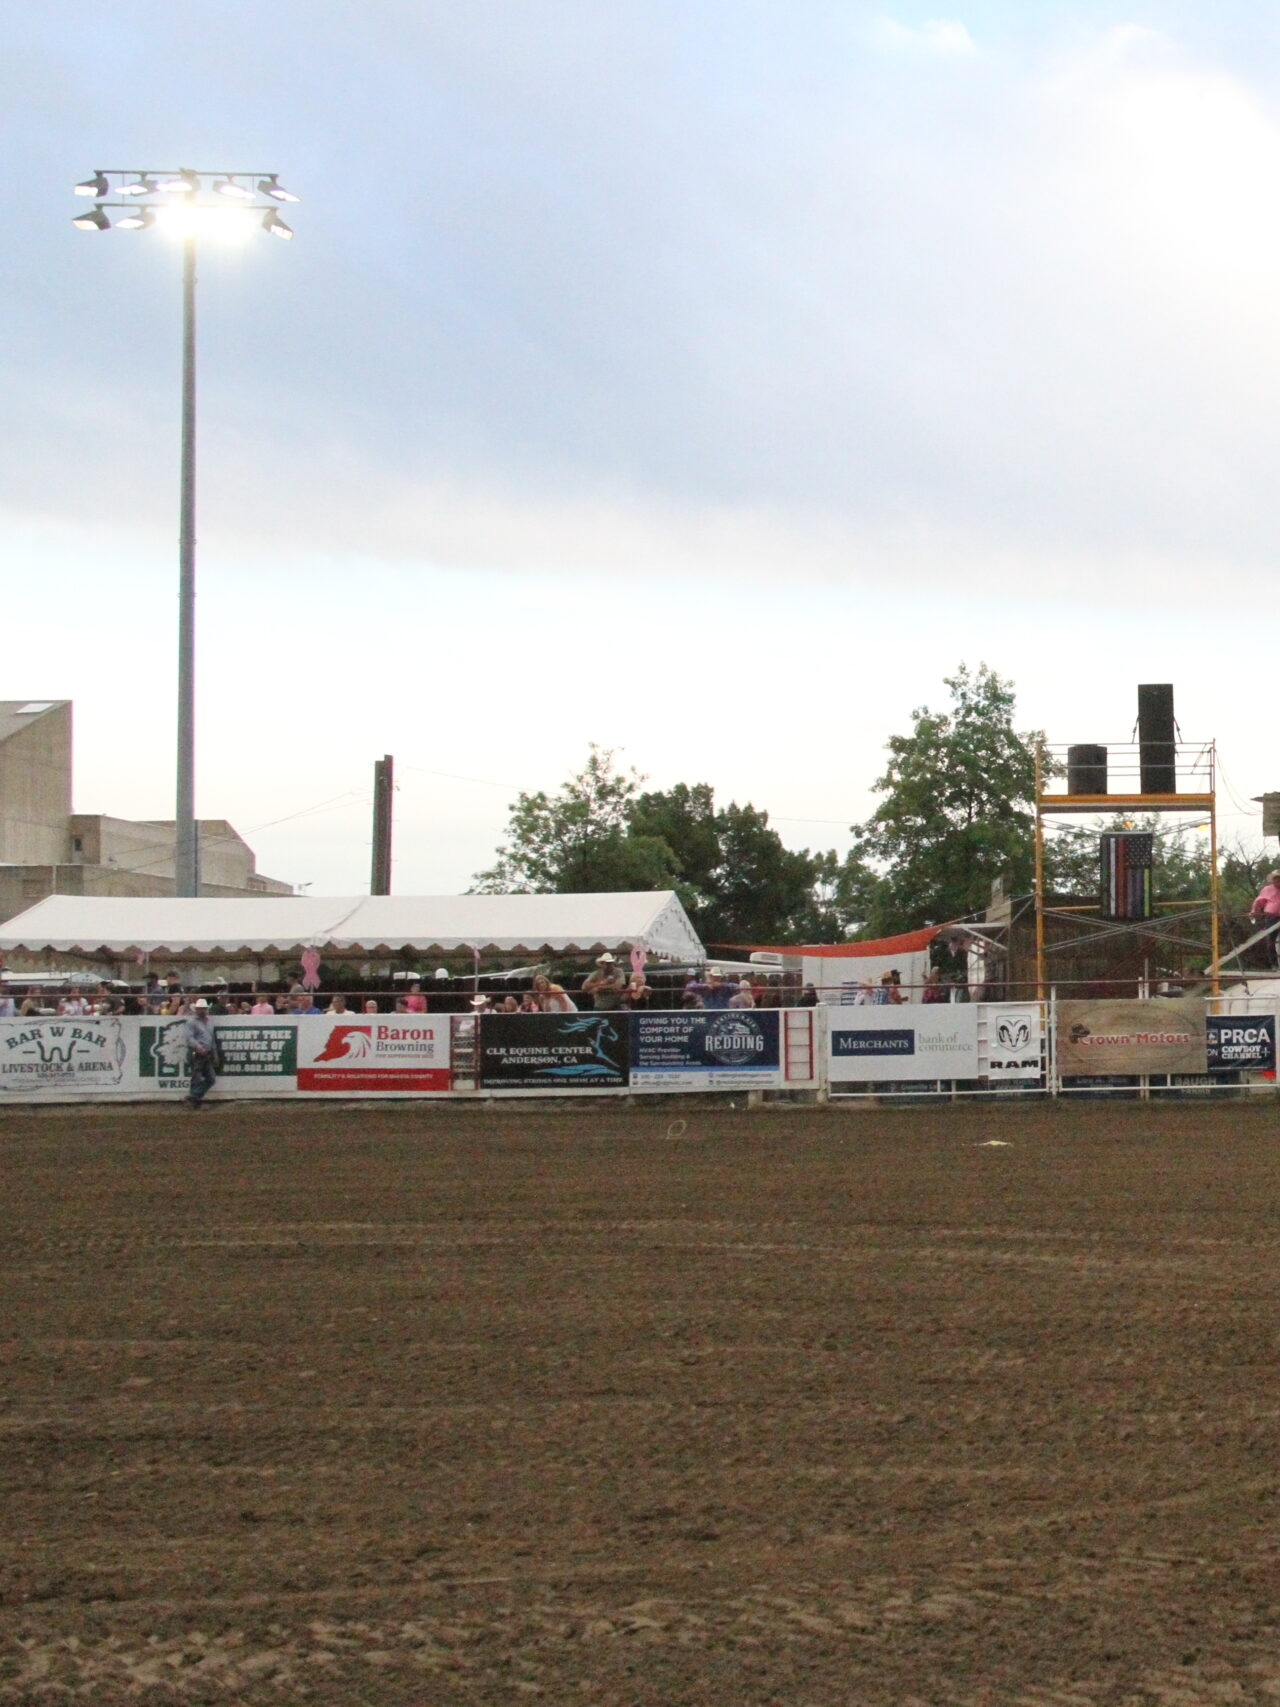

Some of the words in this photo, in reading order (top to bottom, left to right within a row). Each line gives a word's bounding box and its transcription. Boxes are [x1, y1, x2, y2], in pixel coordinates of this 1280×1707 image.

[639, 1017, 669, 1025] GIVING
[5, 1028, 43, 1049] BAR
[49, 1026, 65, 1037] W
[70, 1028, 107, 1048] BAR
[215, 1030, 259, 1040] WRIGHT
[262, 1030, 292, 1039] TREE
[377, 1025, 434, 1040] Baron
[918, 1033, 943, 1044] bank
[946, 1031, 959, 1043] of
[1220, 1028, 1270, 1044] PRCA
[664, 1035, 689, 1043] HOME
[705, 1035, 764, 1052] REDDING
[839, 1037, 909, 1049] MERCHANTS
[1079, 1035, 1130, 1046] Crown
[1136, 1032, 1190, 1044] Motors
[221, 1041, 268, 1050] SERVICE
[270, 1041, 286, 1050] OF
[376, 1042, 435, 1054] Browning
[486, 1047, 507, 1055] CLR
[509, 1047, 549, 1055] EQUINE
[551, 1046, 593, 1054] CENTER
[918, 1043, 974, 1051] commerce
[1221, 1045, 1261, 1053] COWBOY
[224, 1052, 246, 1061] THE
[249, 1052, 282, 1061] WEST
[1, 1063, 64, 1074] LIVESTOCK
[66, 1063, 74, 1072] &
[77, 1062, 113, 1072] ARENA
[990, 1060, 1039, 1069] RAM
[158, 1079, 191, 1088] WRIG
